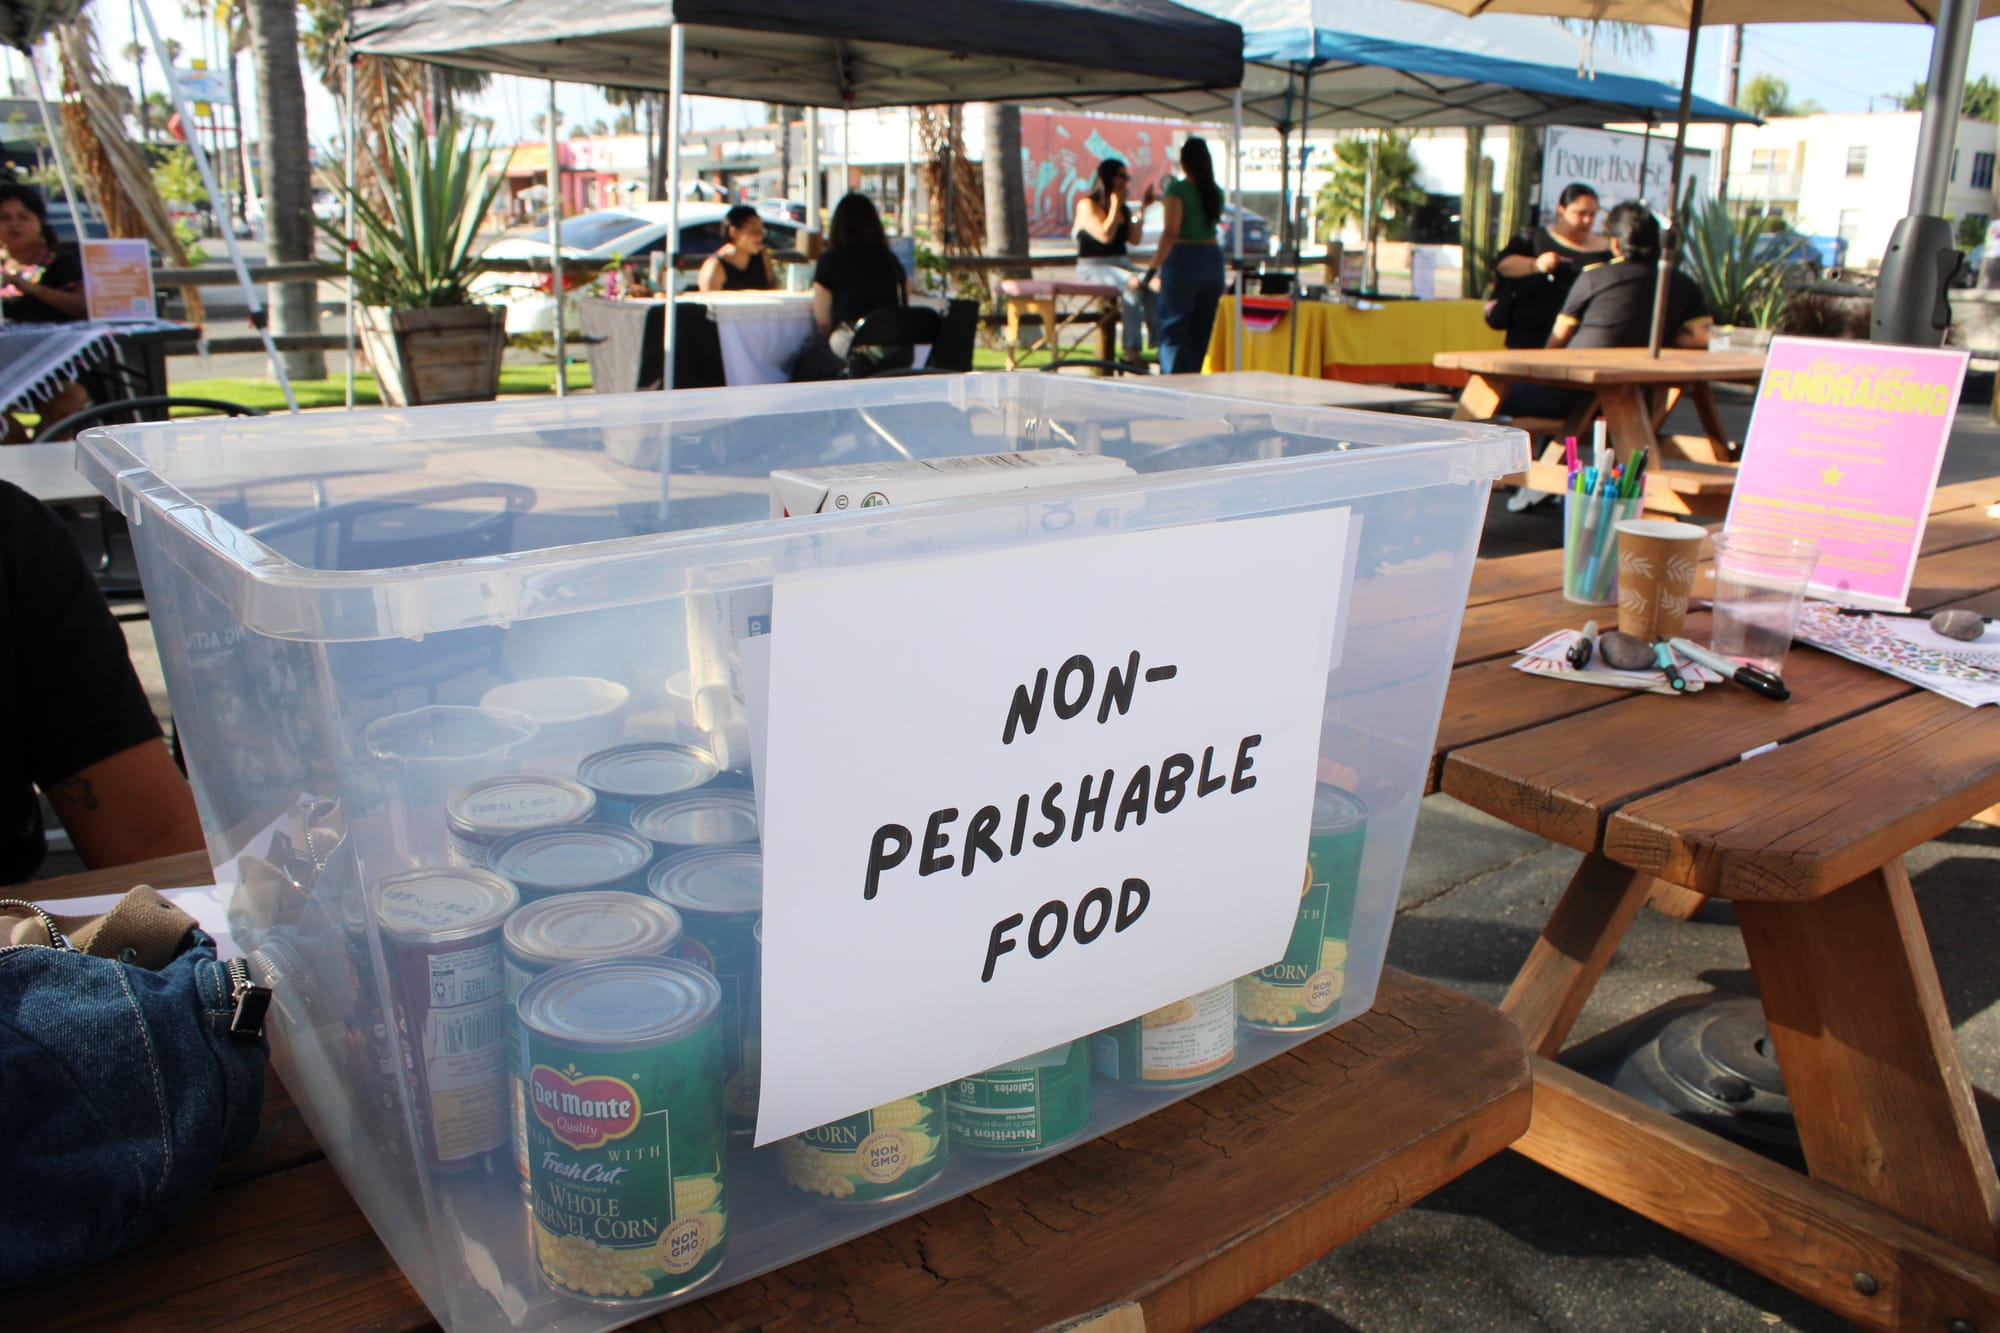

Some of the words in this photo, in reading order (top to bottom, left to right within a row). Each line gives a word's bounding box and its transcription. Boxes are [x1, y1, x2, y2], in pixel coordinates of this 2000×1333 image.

[1763, 368, 1950, 416] FUNDRAISING
[1003, 651, 1177, 745] NON-
[864, 734, 1262, 901] PERISHABLE
[981, 878, 1151, 983] FOOD
[1262, 964, 1309, 980] CORN
[1311, 989, 1331, 1000] GMO
[1312, 981, 1332, 991] NON
[960, 1081, 976, 1095] 60
[994, 1082, 1035, 1094] Calories
[534, 1080, 560, 1111] Del
[561, 1091, 633, 1120] Monte
[556, 1117, 598, 1138] Quality
[804, 1126, 857, 1144] CORN
[951, 1123, 971, 1137] Fac
[974, 1128, 1036, 1141] Nutrition
[607, 1145, 661, 1162] WITH
[871, 1144, 899, 1158] NON
[541, 1151, 582, 1181] Fresh
[579, 1163, 630, 1185] Cut
[871, 1154, 900, 1168] GMO
[549, 1182, 621, 1217] WHOLE
[594, 1217, 658, 1240] CORN
[671, 1228, 698, 1248] NON
[671, 1239, 699, 1258] GMO
